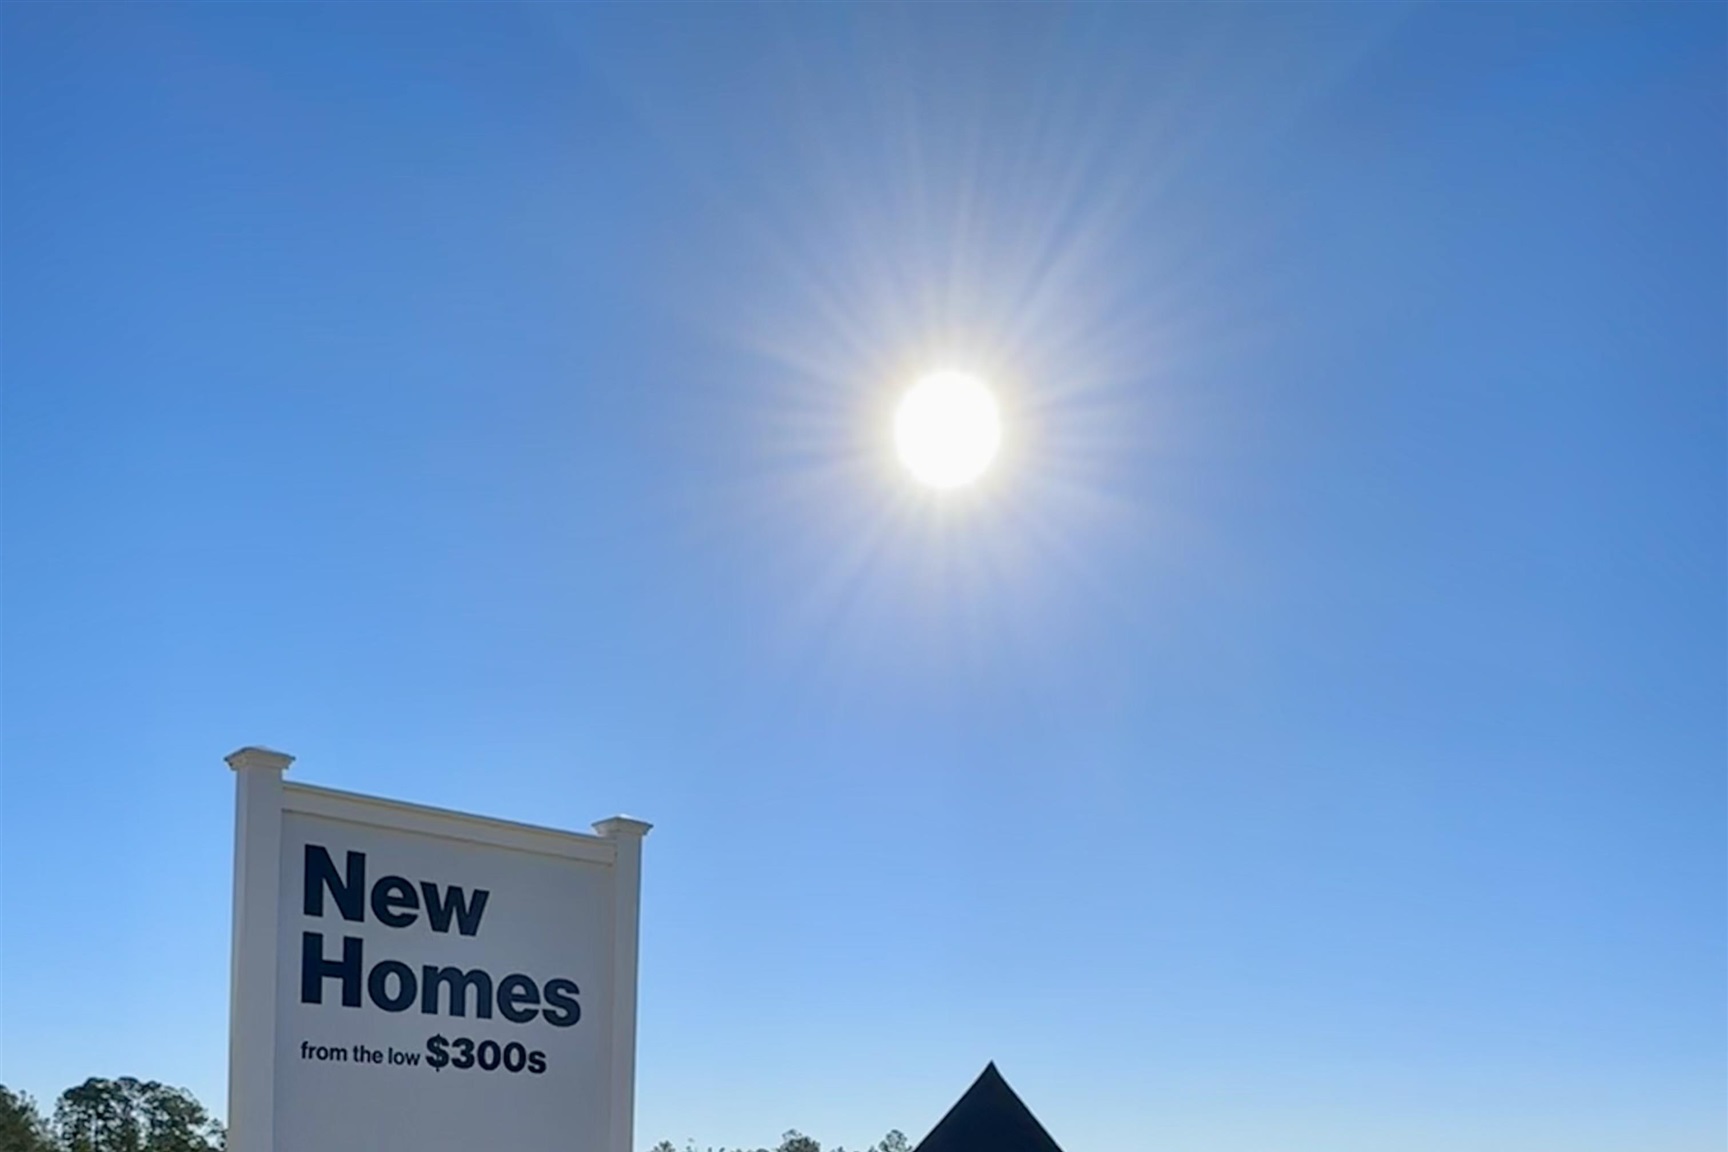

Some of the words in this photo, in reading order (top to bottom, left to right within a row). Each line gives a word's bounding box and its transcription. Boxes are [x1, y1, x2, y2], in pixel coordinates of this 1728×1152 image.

[303, 843, 490, 937] New
[300, 931, 582, 1028] Homes
[300, 1041, 348, 1062] from
[352, 1045, 384, 1064] the
[388, 1047, 421, 1066] low
[425, 1033, 547, 1074] $300s
